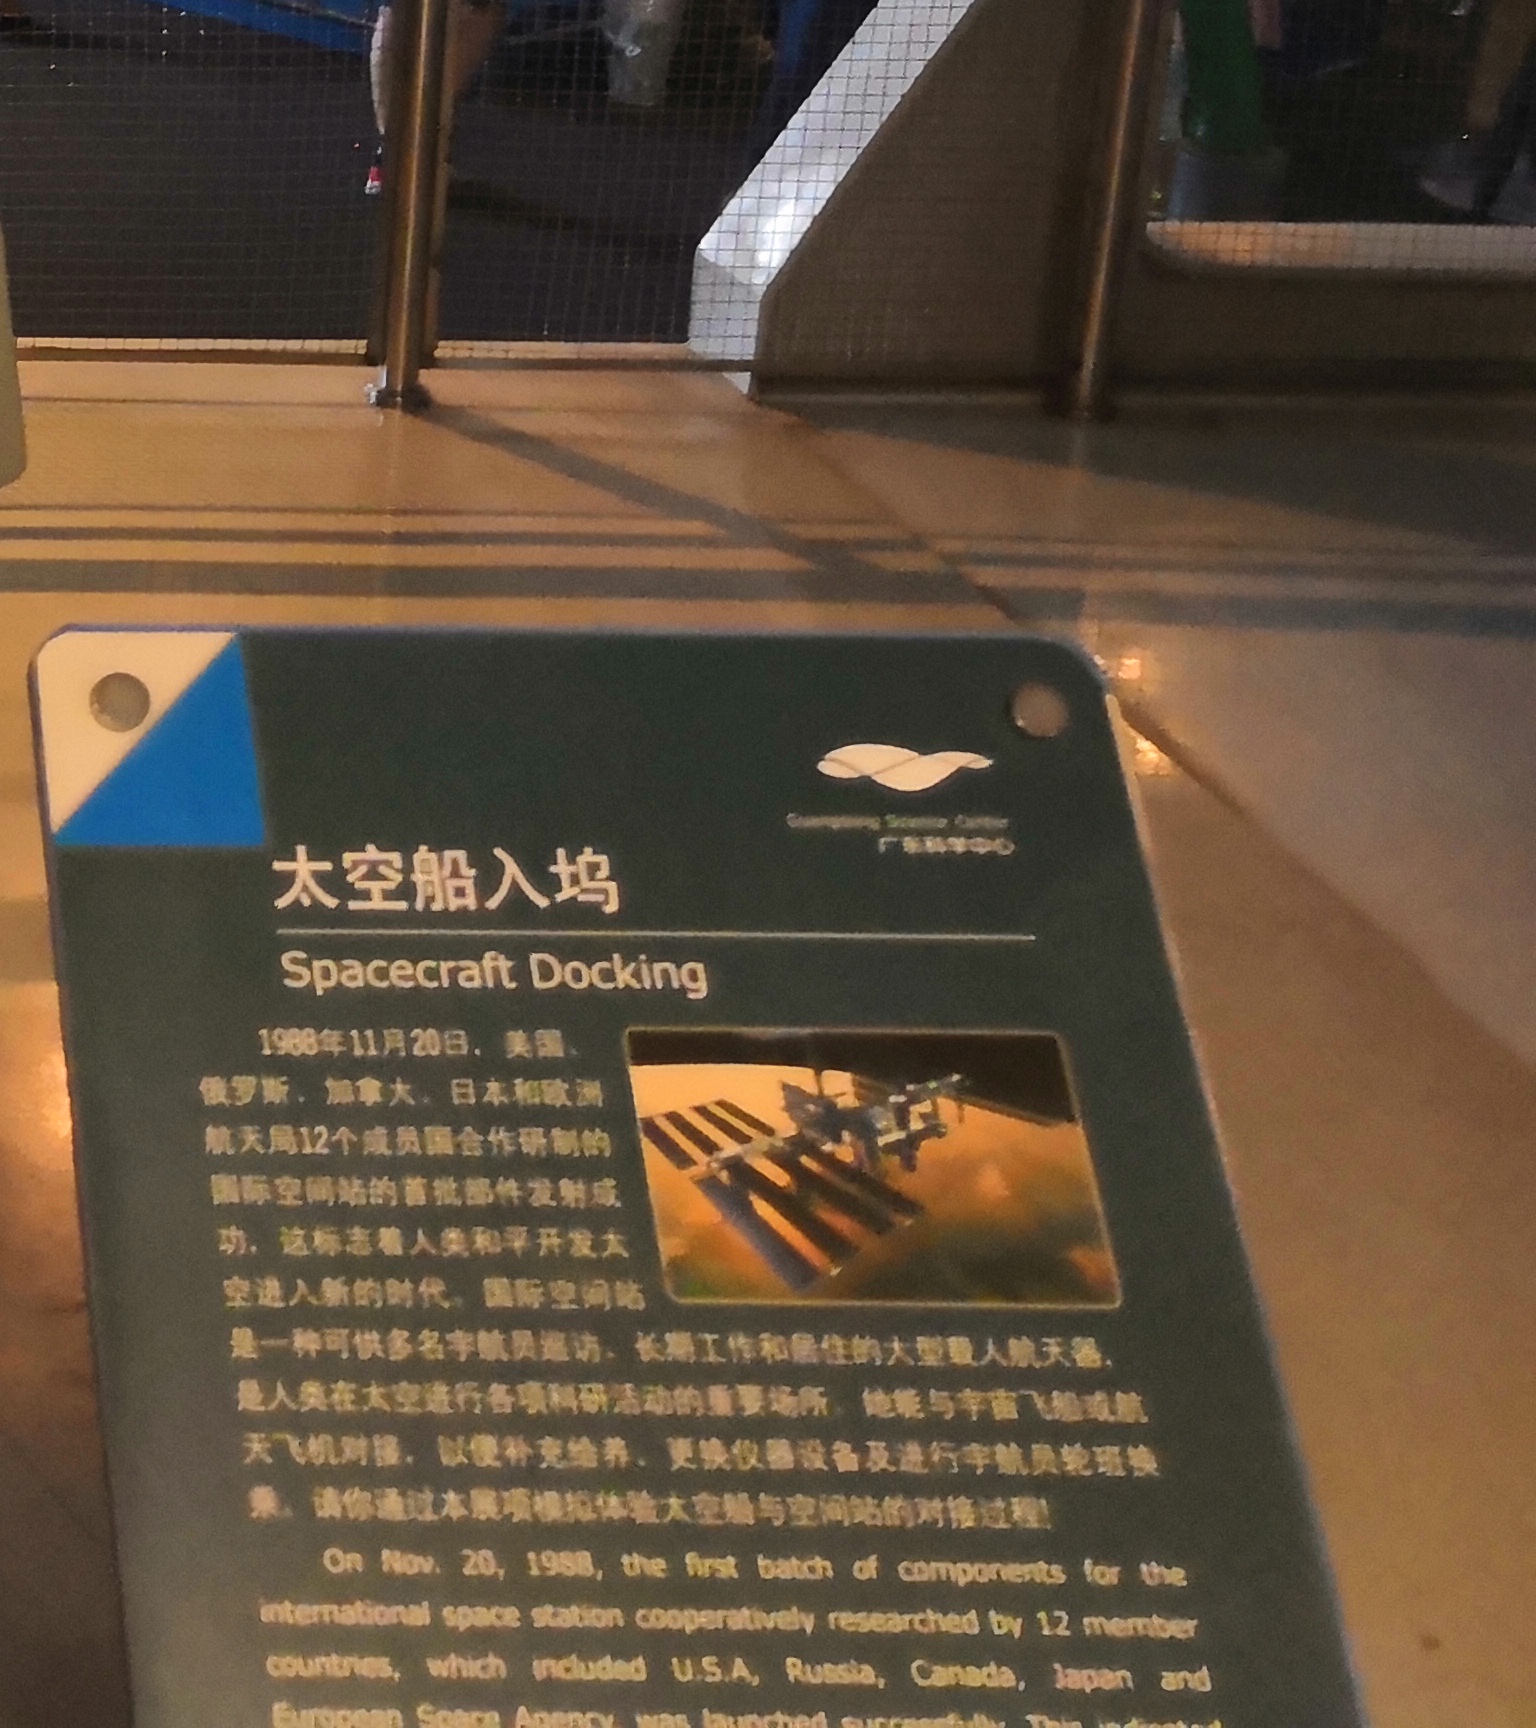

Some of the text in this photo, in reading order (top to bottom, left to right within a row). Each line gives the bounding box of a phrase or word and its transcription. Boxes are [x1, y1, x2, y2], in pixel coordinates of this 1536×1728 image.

[272, 844, 619, 914] 太空船入坞
[281, 951, 708, 999] Spacecraft Docking
[323, 1547, 363, 1574] On
[381, 1549, 440, 1575] Nov.
[621, 1553, 667, 1578] the
[685, 1552, 738, 1578] first
[757, 1555, 833, 1579] batch
[853, 1555, 878, 1580] of
[898, 1561, 1066, 1587] components
[1084, 1559, 1120, 1585] for
[1140, 1561, 1187, 1586] the
[260, 1600, 1198, 1639] international space station cooperatively researched by 12 member
[266, 1654, 400, 1681] countries,
[427, 1654, 506, 1679] which
[533, 1655, 647, 1681] included
[786, 1658, 885, 1688] Russia,
[911, 1660, 1025, 1691] Canada,
[1053, 1663, 1133, 1693] Japan
[1161, 1666, 1211, 1692] and
